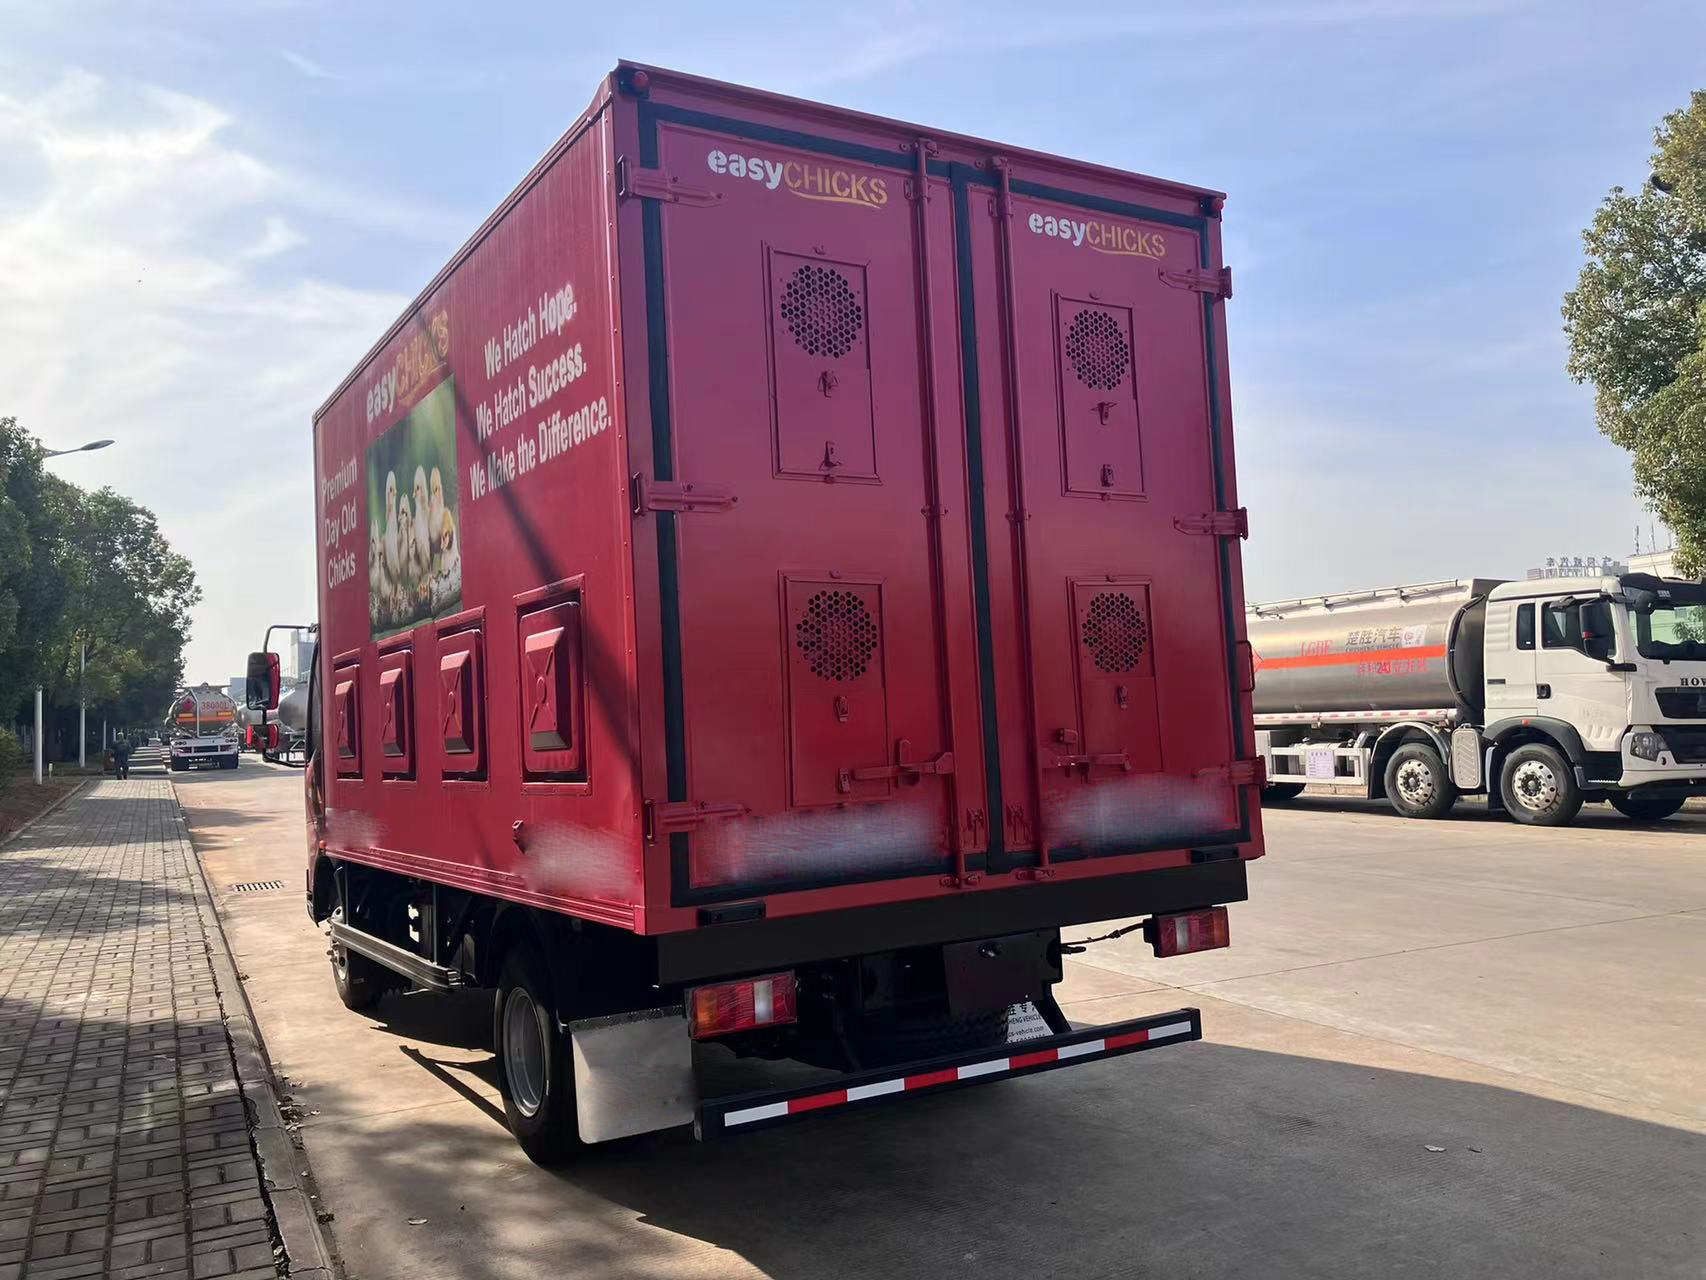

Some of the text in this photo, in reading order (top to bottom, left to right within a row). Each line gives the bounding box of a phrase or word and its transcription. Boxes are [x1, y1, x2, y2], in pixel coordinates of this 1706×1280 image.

[707, 149, 889, 206] easyCHICKS
[1028, 211, 1167, 258] easyCHICKS
[484, 283, 577, 380] We Hatch Hope.
[476, 342, 587, 442] We Hatch Success.
[470, 395, 612, 501] We Make the Difference.
[321, 455, 358, 507] Premium
[324, 500, 357, 546] Day Old
[327, 551, 356, 589] Chicks
